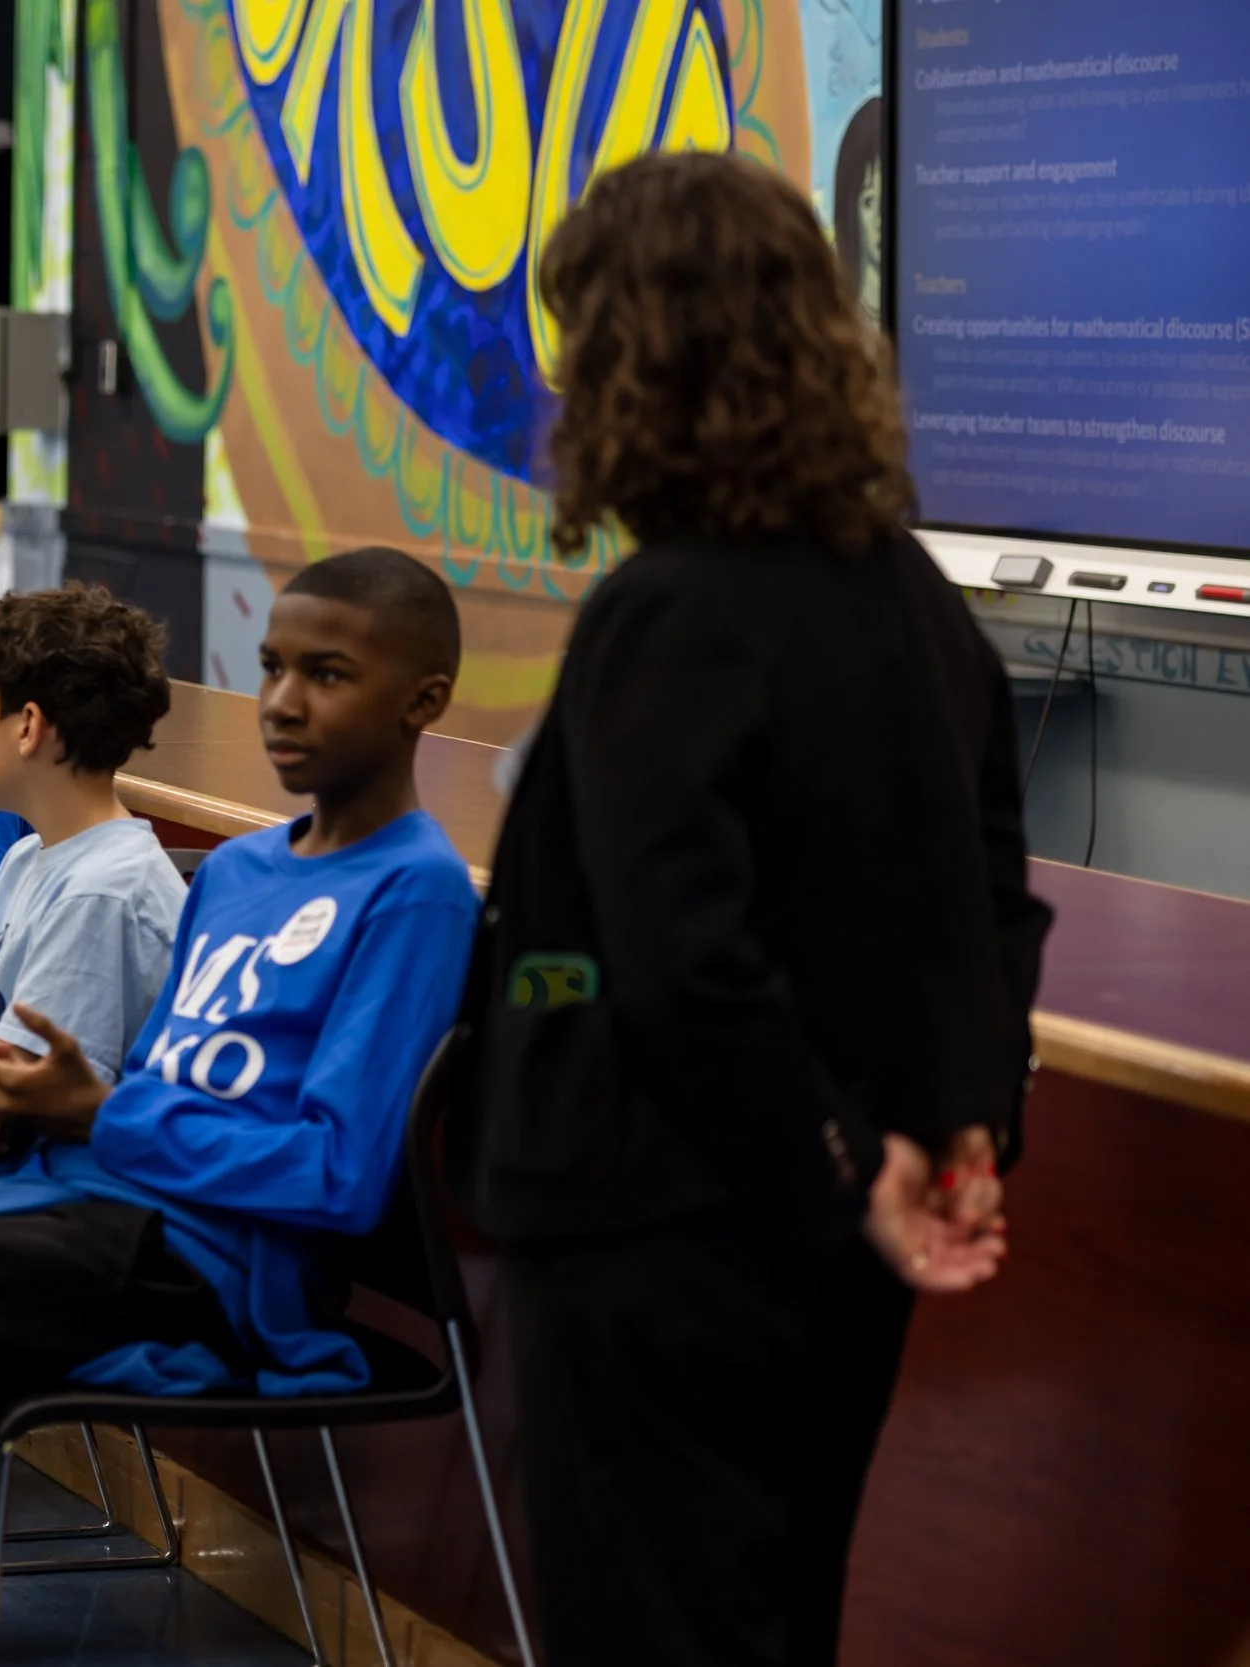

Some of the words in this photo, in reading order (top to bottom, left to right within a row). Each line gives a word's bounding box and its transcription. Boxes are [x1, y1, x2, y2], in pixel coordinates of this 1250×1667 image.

[1023, 53, 1112, 82] mathematical
[1114, 52, 1179, 75] discourse
[962, 163, 1010, 187] support
[1012, 158, 1036, 181] and
[1038, 157, 1118, 184] engagement
[912, 314, 964, 341] Creating
[966, 314, 1049, 340] opportunities
[1050, 314, 1070, 337] for
[1072, 315, 1164, 339] mathematical
[1166, 316, 1233, 340] discourse
[914, 408, 977, 436] Leveraging
[978, 411, 1025, 433] teacher
[1026, 415, 1066, 436] teams
[1067, 416, 1082, 437] to
[1084, 416, 1157, 444] strengthen
[1158, 418, 1227, 445] discourse
